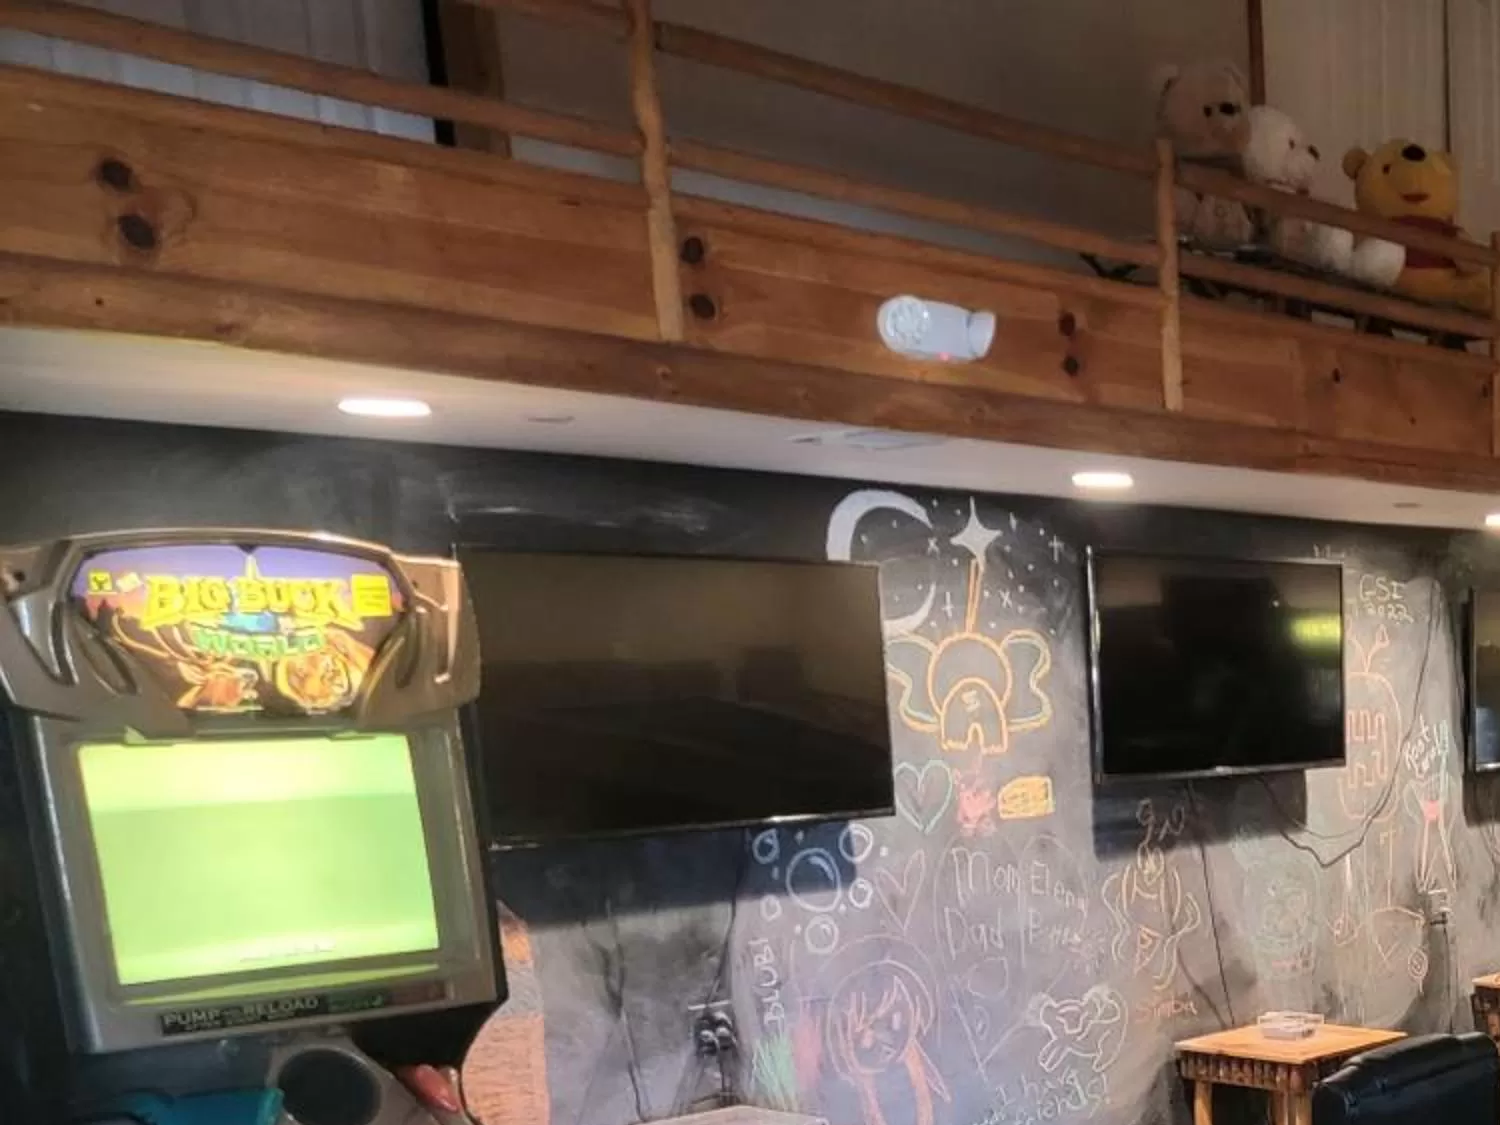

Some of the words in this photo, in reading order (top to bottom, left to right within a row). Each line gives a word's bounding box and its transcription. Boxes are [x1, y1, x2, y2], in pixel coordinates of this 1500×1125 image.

[143, 576, 231, 622] BIG
[234, 575, 357, 622] BUCK
[192, 627, 326, 659] WORLD
[163, 1008, 221, 1026] PUMP
[243, 996, 319, 1017] RELOAD
